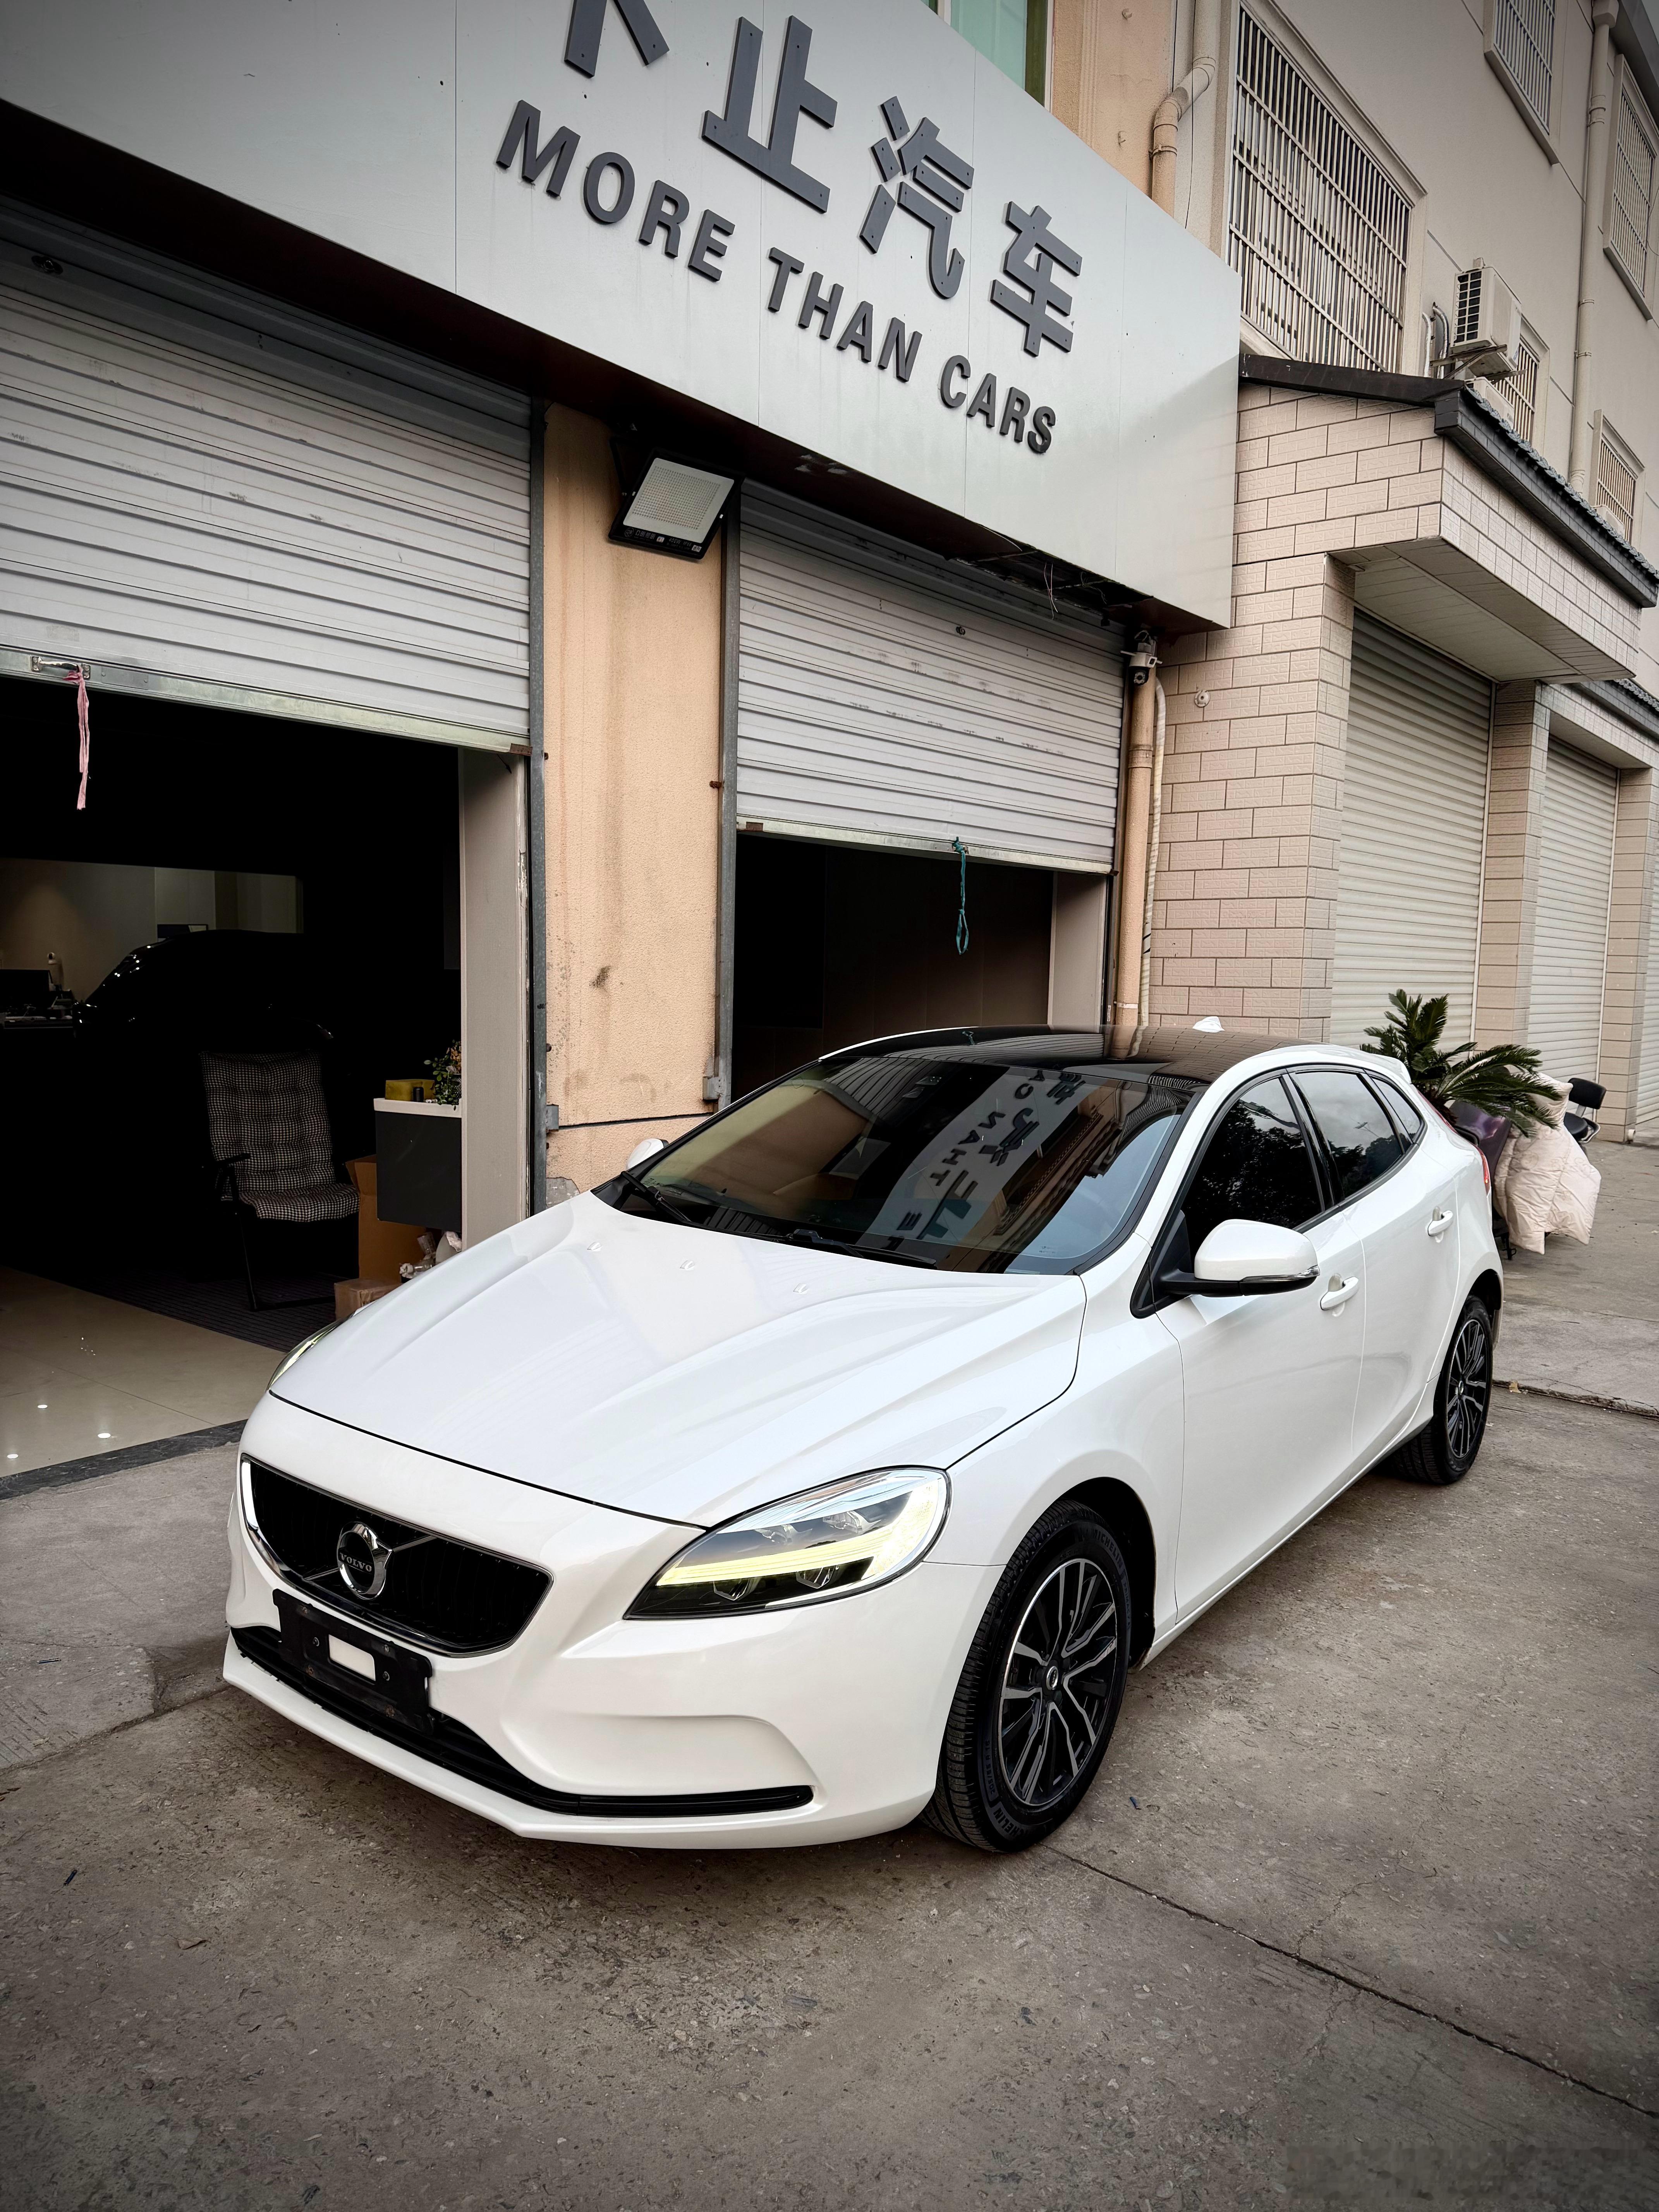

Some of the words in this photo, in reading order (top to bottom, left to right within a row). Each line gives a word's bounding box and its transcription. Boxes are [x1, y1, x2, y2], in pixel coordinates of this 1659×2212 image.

[496, 100, 735, 282] MORE
[768, 247, 922, 382] THAN
[940, 355, 1056, 453] CARS
[340, 1553, 372, 1572] VOLVO
[986, 1764, 996, 1795] 205/55
